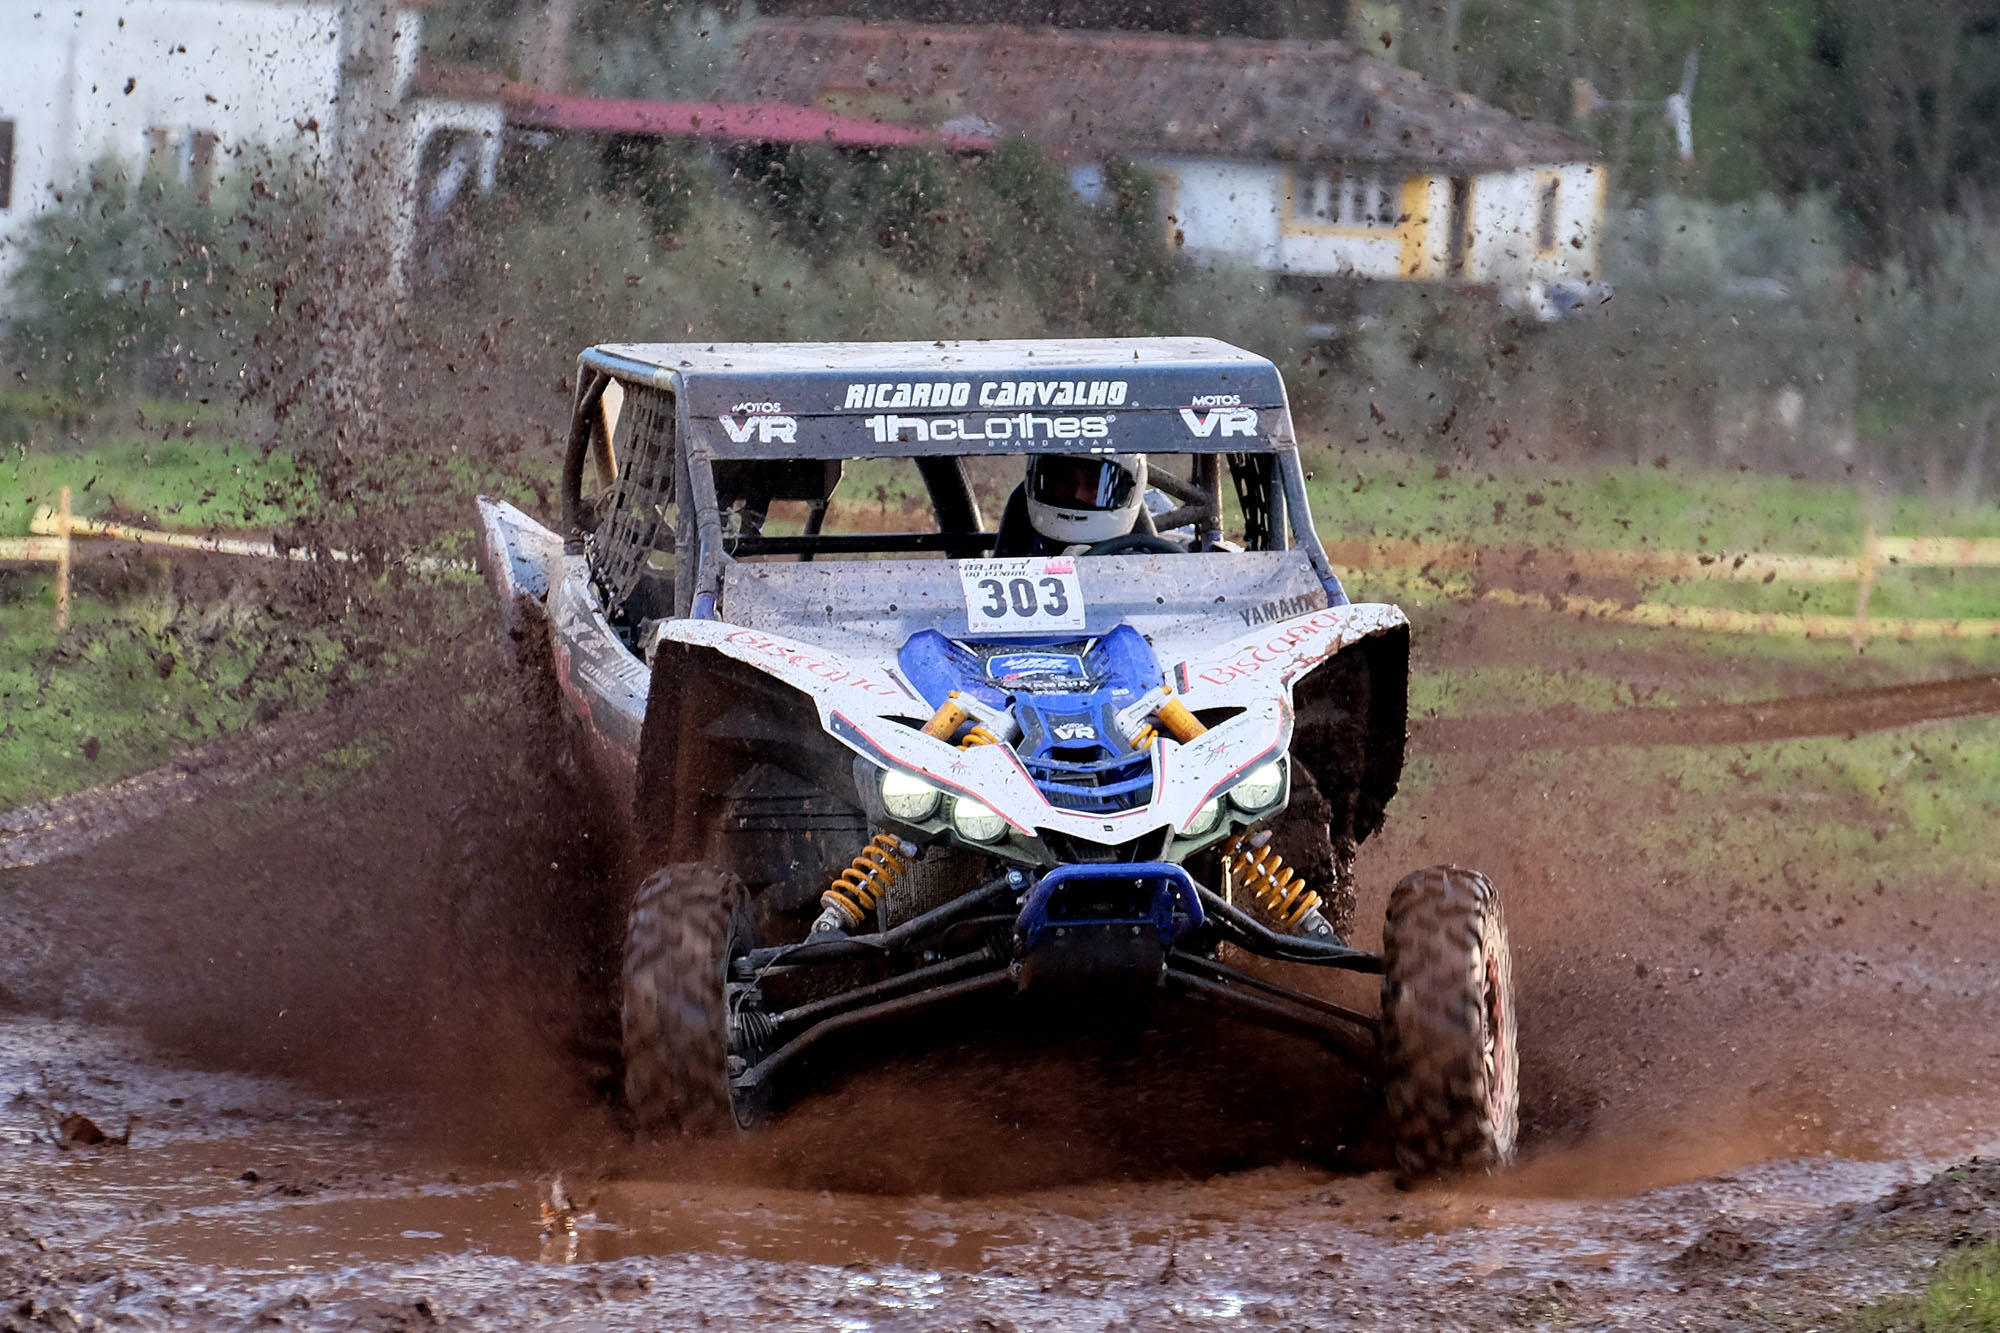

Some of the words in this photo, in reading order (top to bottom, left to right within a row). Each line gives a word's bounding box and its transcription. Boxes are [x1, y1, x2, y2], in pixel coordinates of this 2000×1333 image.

[731, 402, 781, 412] MOTOS
[844, 383, 971, 409] RICARDO
[980, 382, 1128, 407] CARVALHO
[1192, 395, 1241, 406] MOTOS
[718, 415, 798, 443] VR
[1179, 407, 1259, 437] VR
[978, 577, 1069, 618] 303
[1053, 726, 1095, 740] VR
